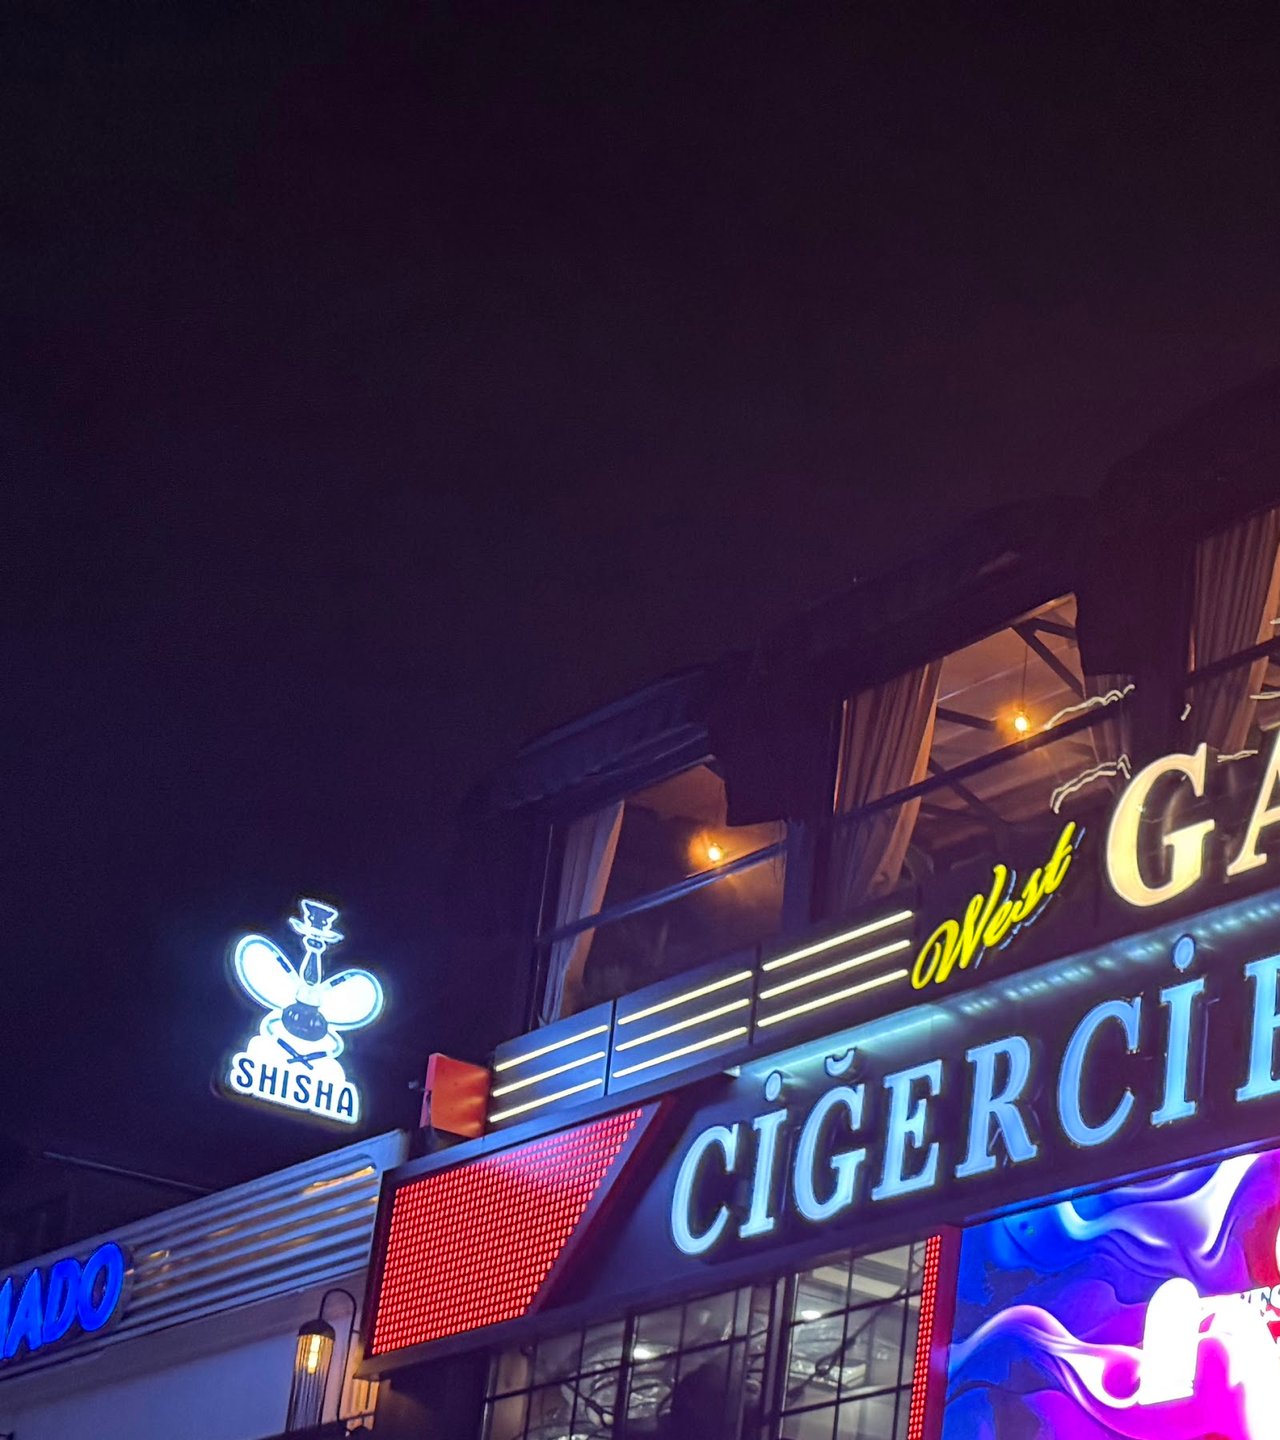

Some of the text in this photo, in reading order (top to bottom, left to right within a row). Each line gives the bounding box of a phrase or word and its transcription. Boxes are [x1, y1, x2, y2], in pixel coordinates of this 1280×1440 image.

[911, 820, 1077, 988] West
[236, 1058, 354, 1117] SHISHA
[671, 935, 1206, 1256] CİĞERCİ
